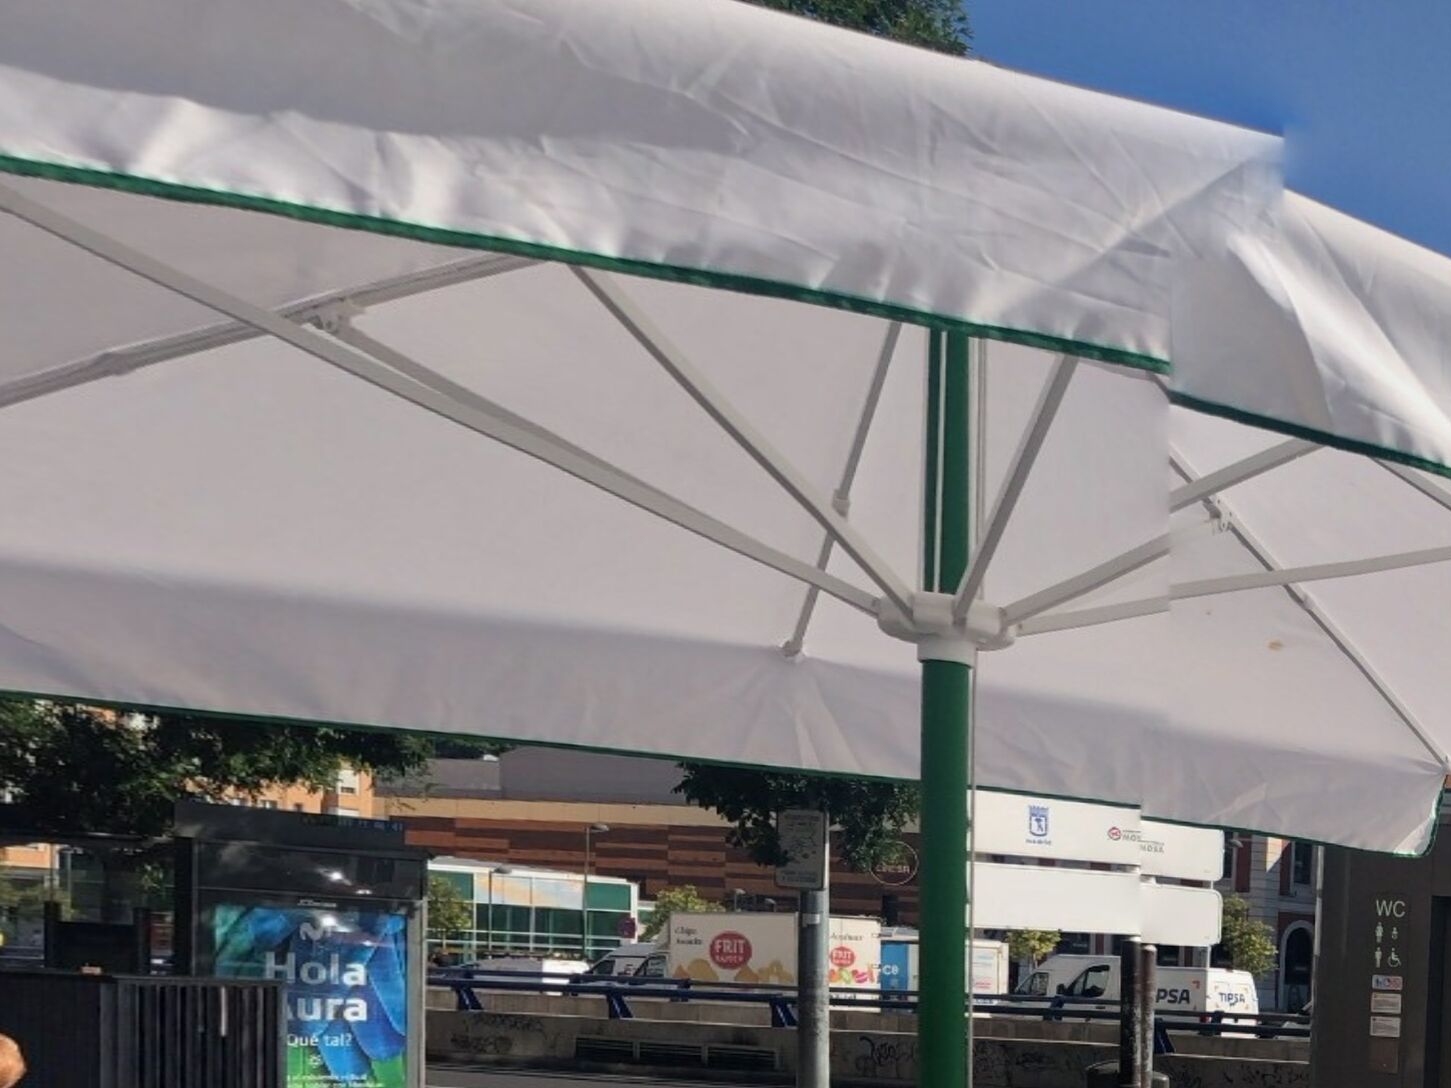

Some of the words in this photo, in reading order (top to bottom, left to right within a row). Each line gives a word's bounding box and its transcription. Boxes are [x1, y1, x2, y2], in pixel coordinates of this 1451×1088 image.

[1376, 899, 1406, 918] WC
[714, 938, 746, 953] FRIT
[265, 952, 368, 986] Hola
[1156, 988, 1190, 1004] PSA
[1219, 992, 1246, 1004] TIPSA
